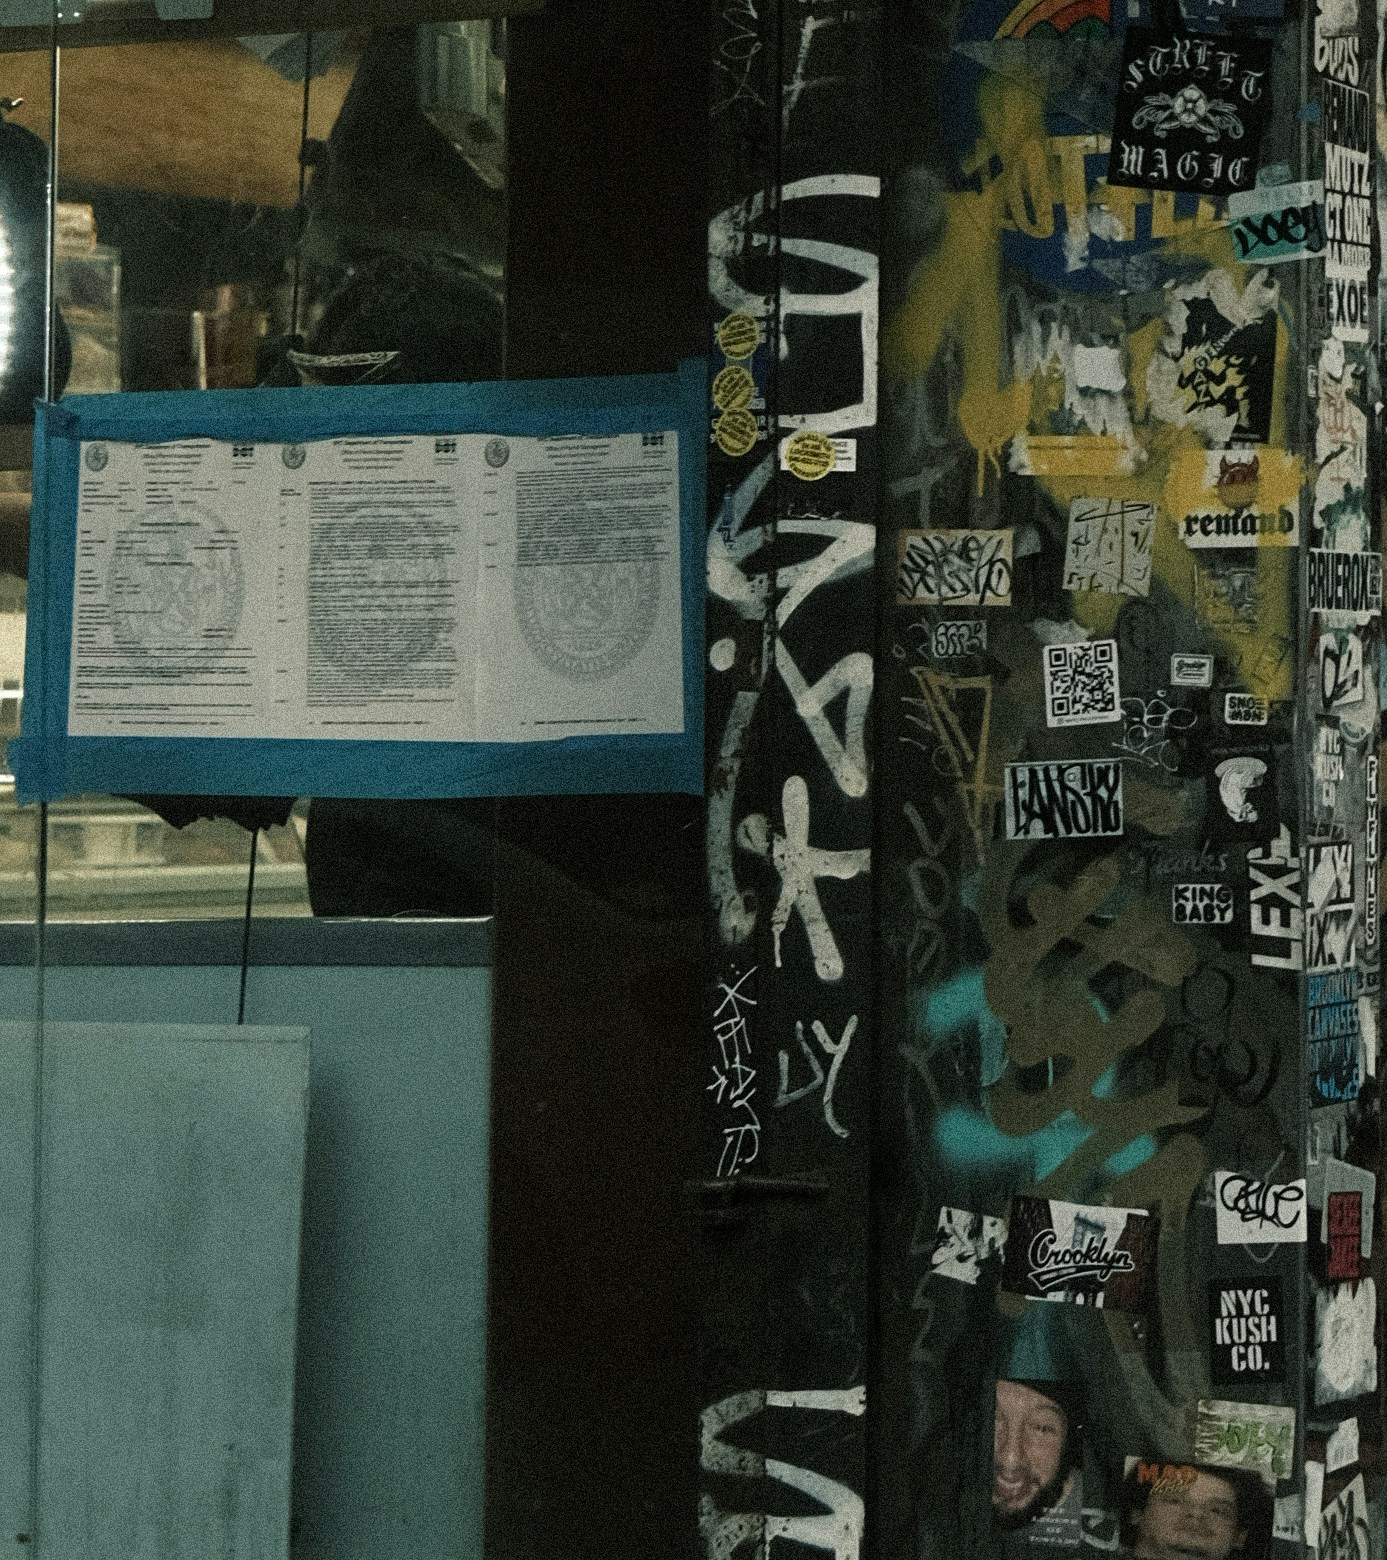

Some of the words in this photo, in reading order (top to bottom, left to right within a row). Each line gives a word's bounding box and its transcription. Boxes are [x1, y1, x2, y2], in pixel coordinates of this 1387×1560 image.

[1118, 140, 1250, 188] MAGIC
[1175, 886, 1232, 904] KING
[1174, 903, 1233, 923] BABY
[1028, 1228, 1136, 1290] Crooklyn
[1219, 1288, 1270, 1317] NYC
[1213, 1315, 1279, 1345] KUSH
[1230, 1344, 1271, 1372] CO.
